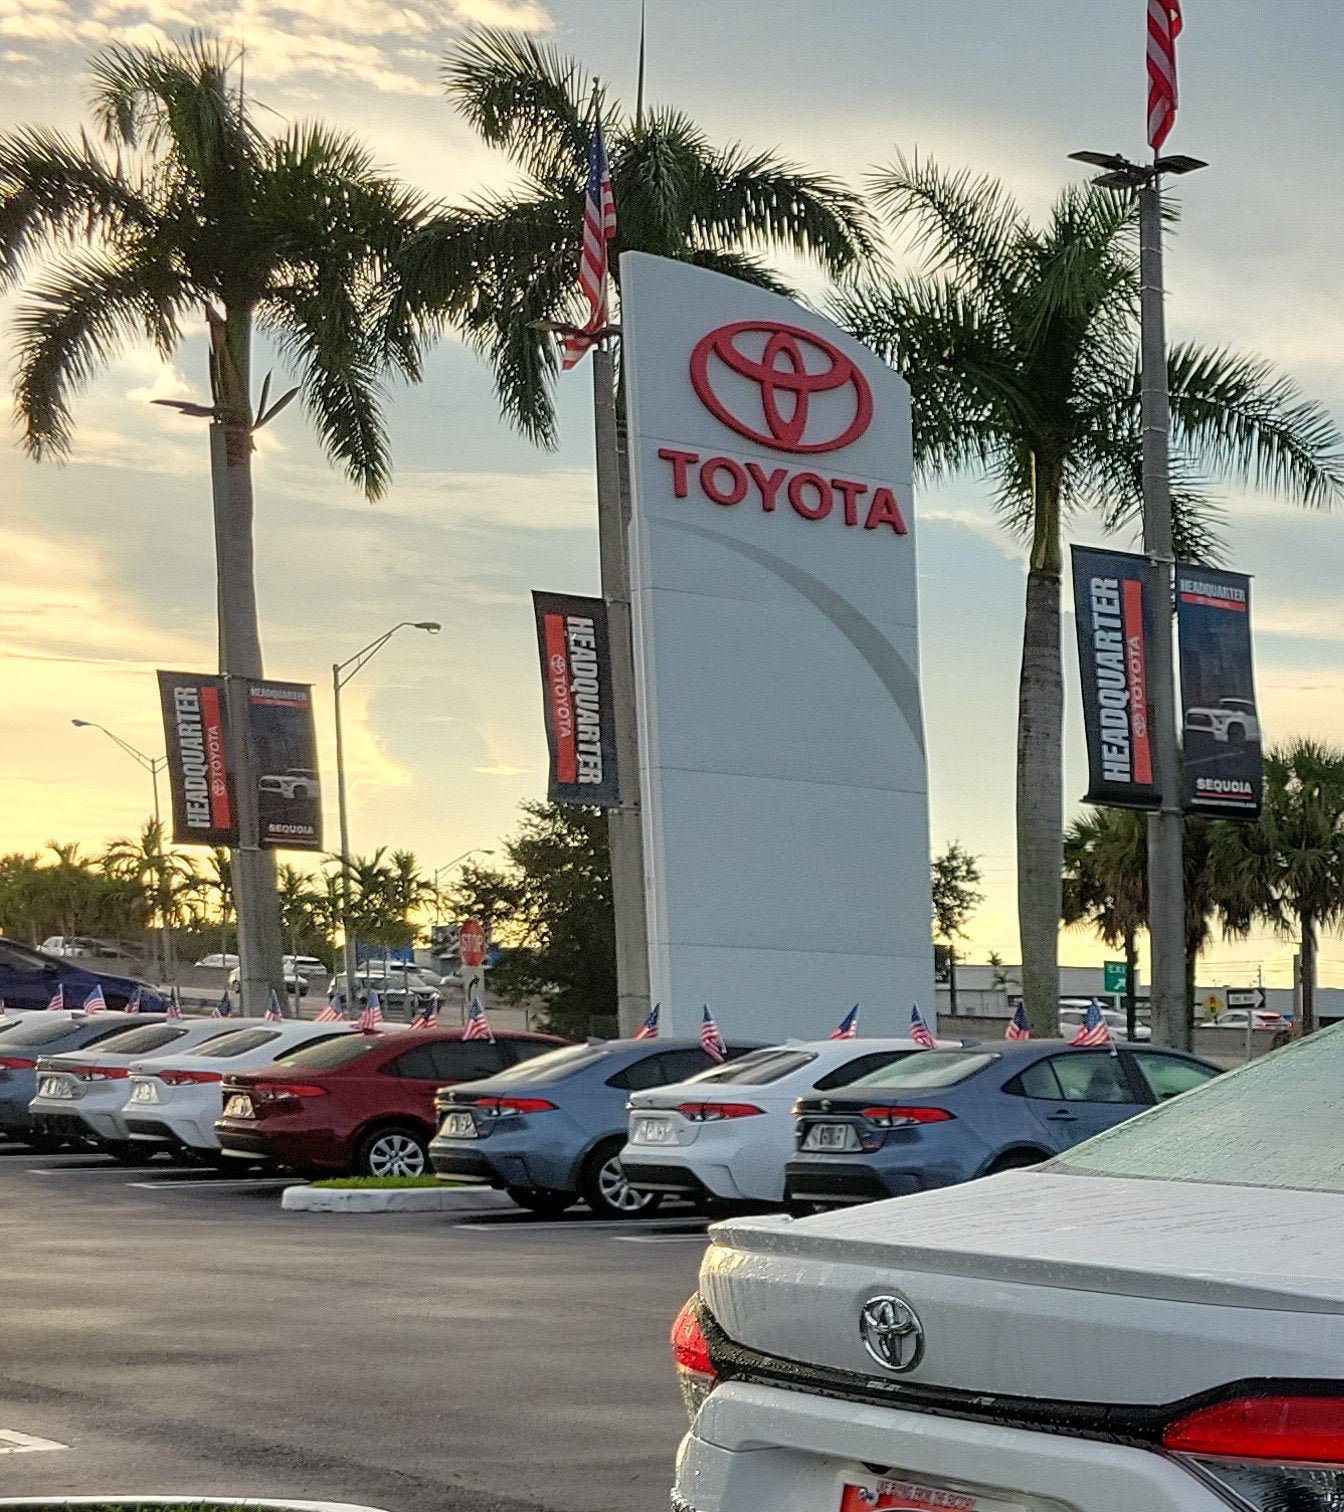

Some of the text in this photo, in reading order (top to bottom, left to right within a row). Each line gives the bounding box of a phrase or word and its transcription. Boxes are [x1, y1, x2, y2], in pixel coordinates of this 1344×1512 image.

[658, 448, 907, 535] TOYOTA
[566, 615, 603, 784] HEADQUARTER
[1091, 577, 1130, 783] HEADQUARTER
[1128, 635, 1143, 710] TOYOTA
[554, 676, 572, 738] TOYOTA
[174, 686, 211, 828] HEADQUARTER
[208, 725, 226, 777] TOYOTA
[1196, 777, 1253, 794] SEQUOIA
[268, 823, 314, 835] SEQUOIA
[461, 933, 483, 952] STOP
